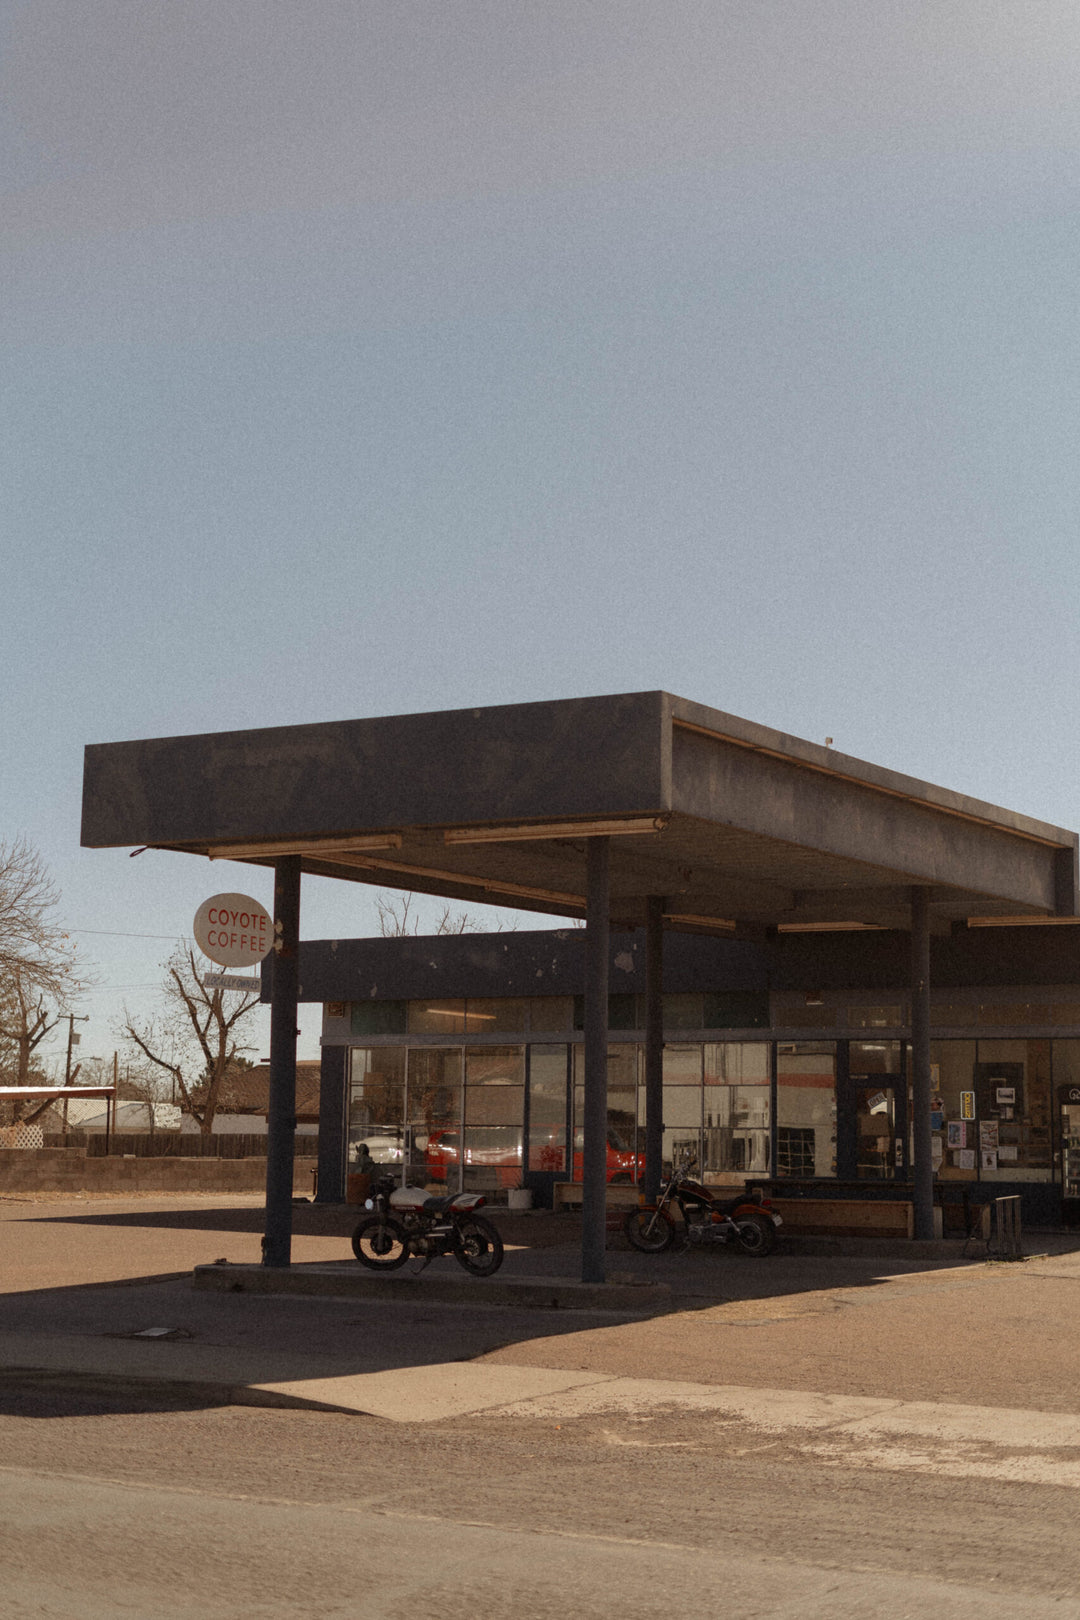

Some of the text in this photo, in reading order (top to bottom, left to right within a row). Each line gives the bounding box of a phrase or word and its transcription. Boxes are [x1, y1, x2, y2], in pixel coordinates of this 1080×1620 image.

[208, 908, 267, 931] COYOTE
[207, 930, 266, 952] COFFEE
[206, 975, 260, 990] LOCALLY OWNED
[869, 1094, 885, 1107] OPEN
